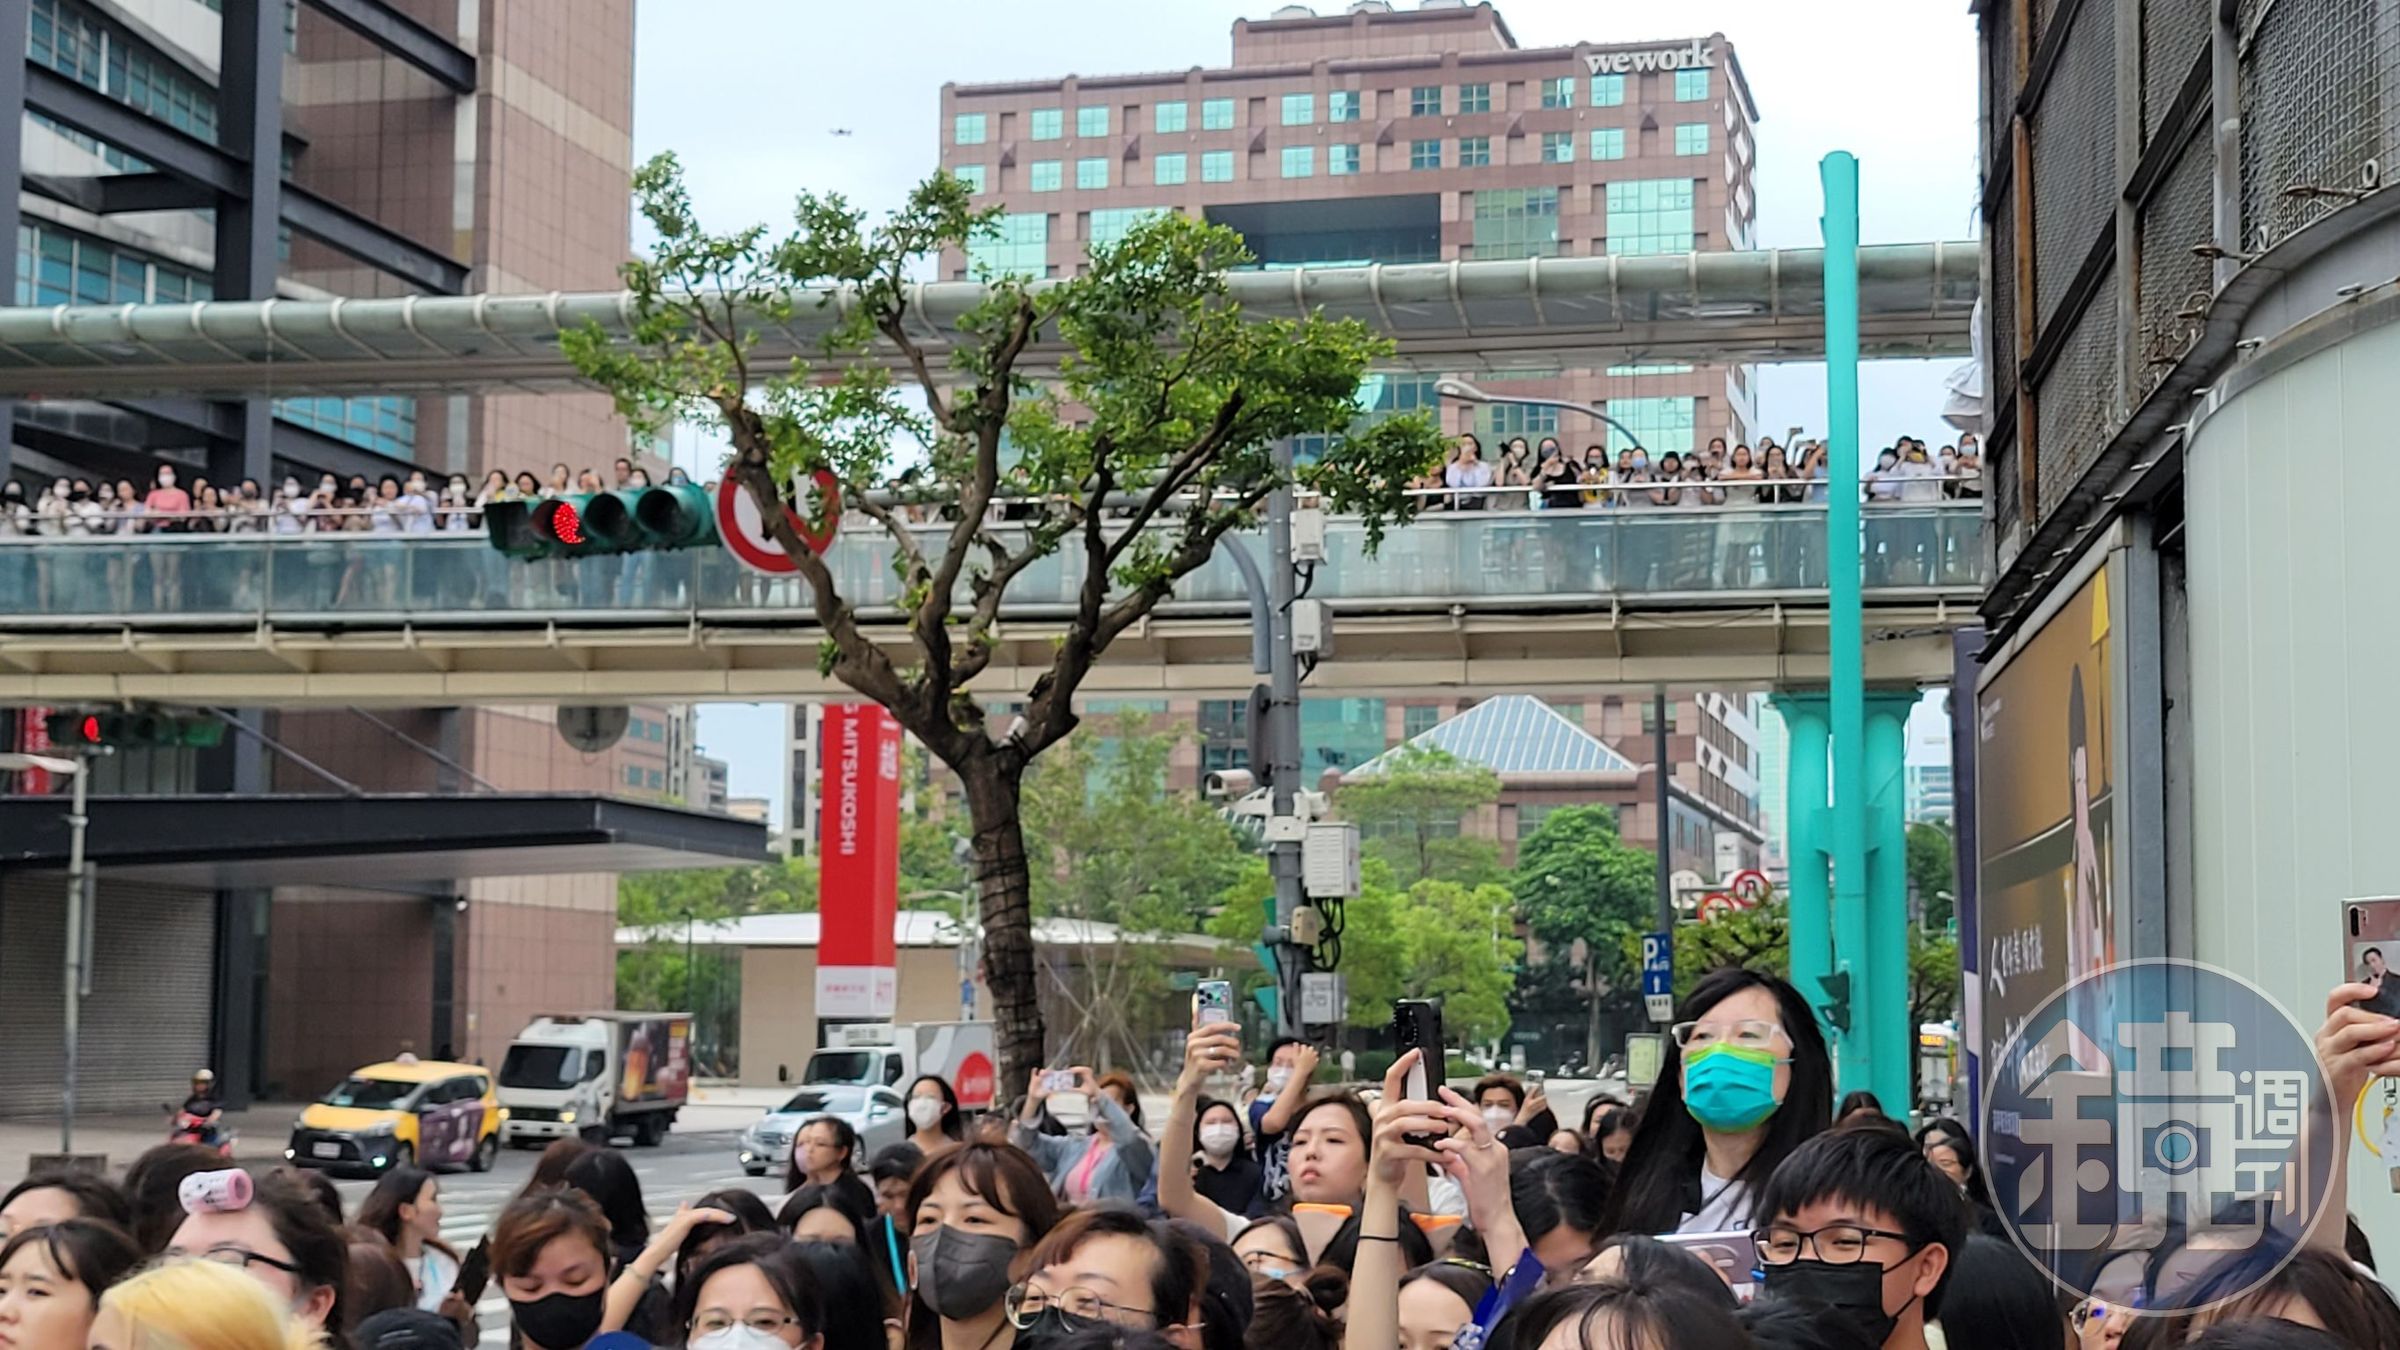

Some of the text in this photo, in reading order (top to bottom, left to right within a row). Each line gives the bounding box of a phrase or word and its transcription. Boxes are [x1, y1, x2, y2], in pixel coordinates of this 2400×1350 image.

[1585, 39, 1716, 74] wework
[840, 718, 859, 855] MITSUKOSHI
[1643, 937, 1659, 971] P
